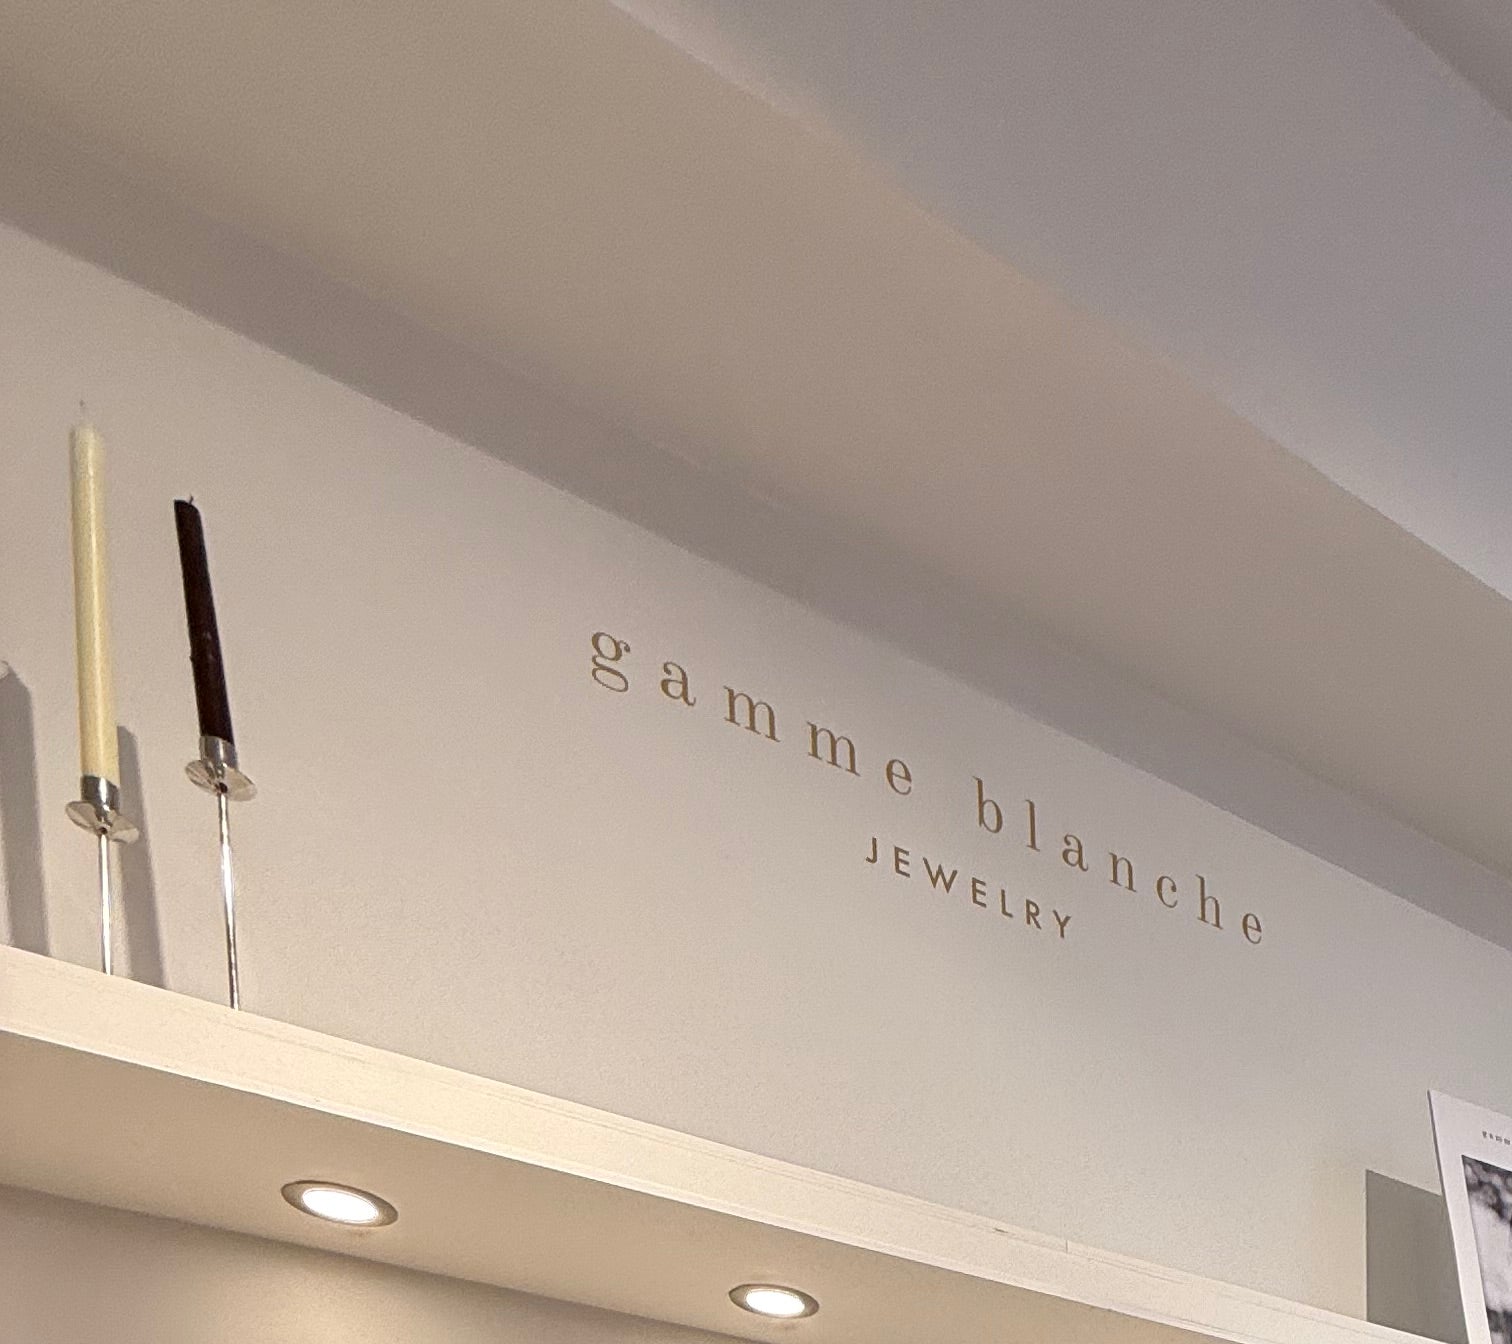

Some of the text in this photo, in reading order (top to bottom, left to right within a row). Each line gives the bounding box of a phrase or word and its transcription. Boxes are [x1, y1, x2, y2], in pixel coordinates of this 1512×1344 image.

[590, 630, 1263, 945] gamme blanche
[865, 835, 1073, 940] JEWELRY
